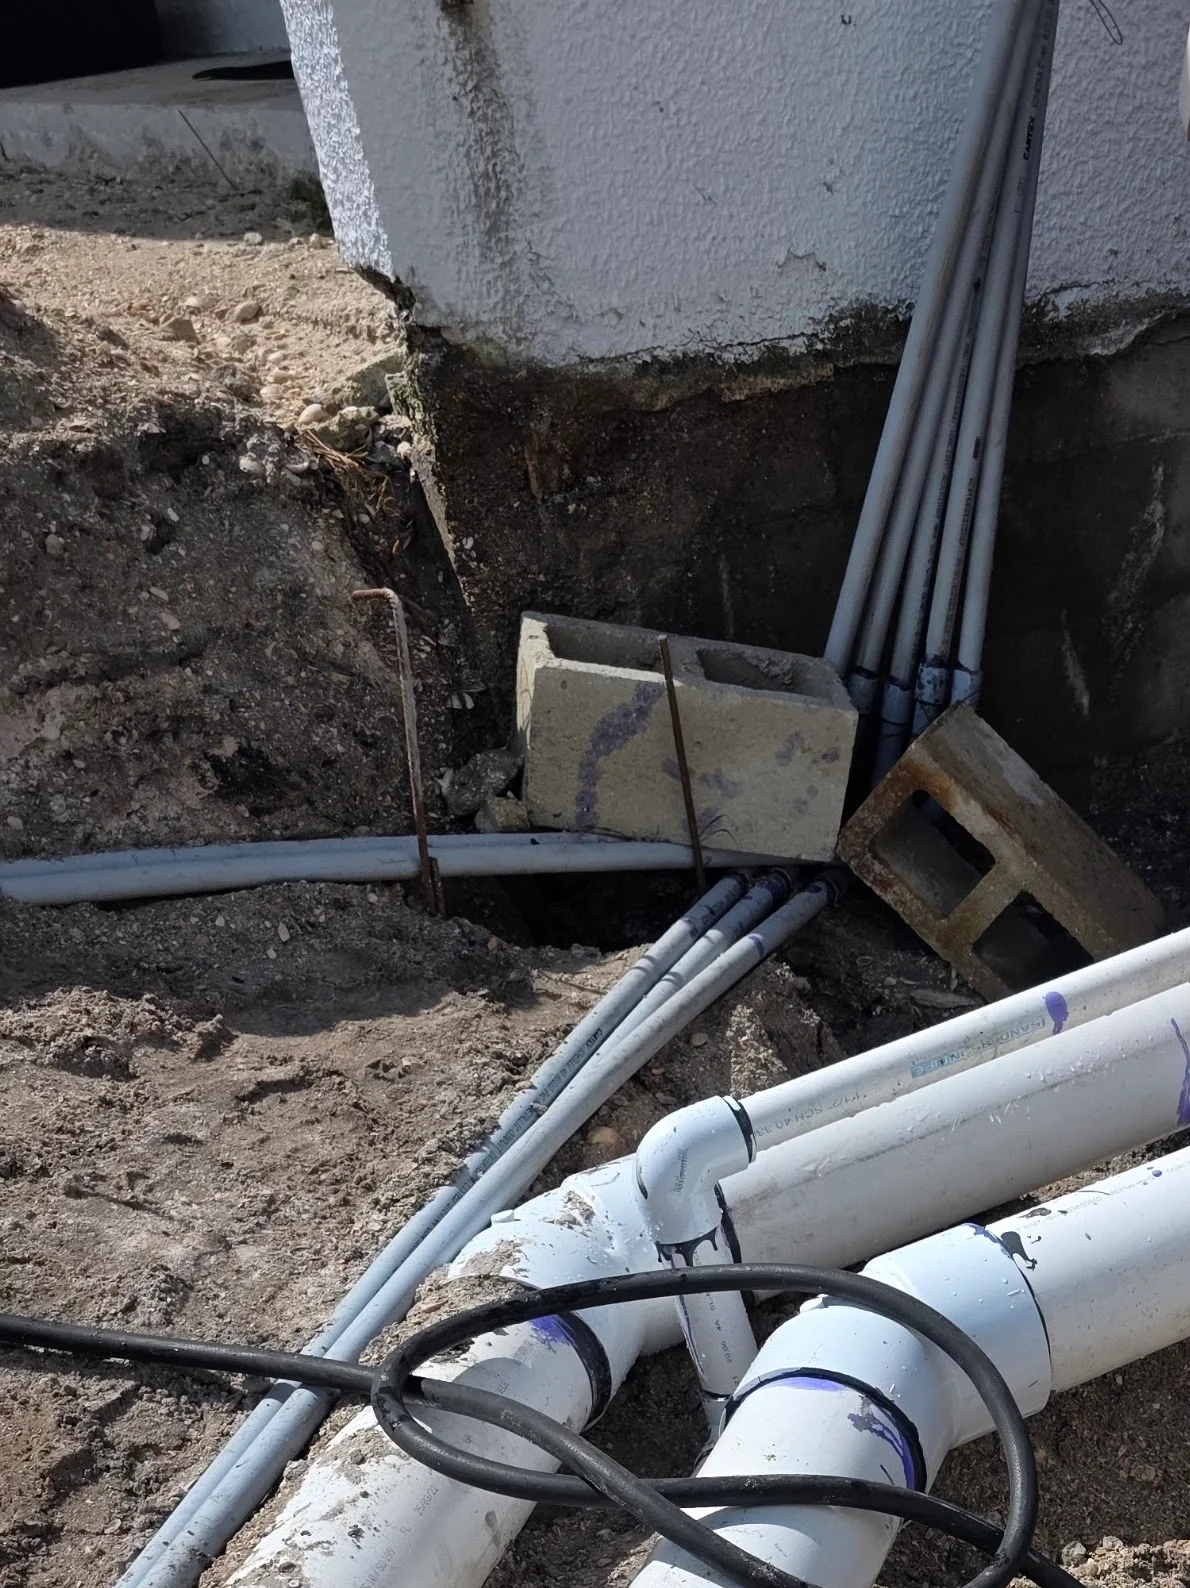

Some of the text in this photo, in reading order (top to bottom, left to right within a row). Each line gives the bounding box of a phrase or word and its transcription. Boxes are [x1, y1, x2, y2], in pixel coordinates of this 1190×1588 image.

[1021, 115, 1035, 160] CANTEX
[774, 1116, 791, 1129] 40
[794, 1103, 825, 1123] SCH
